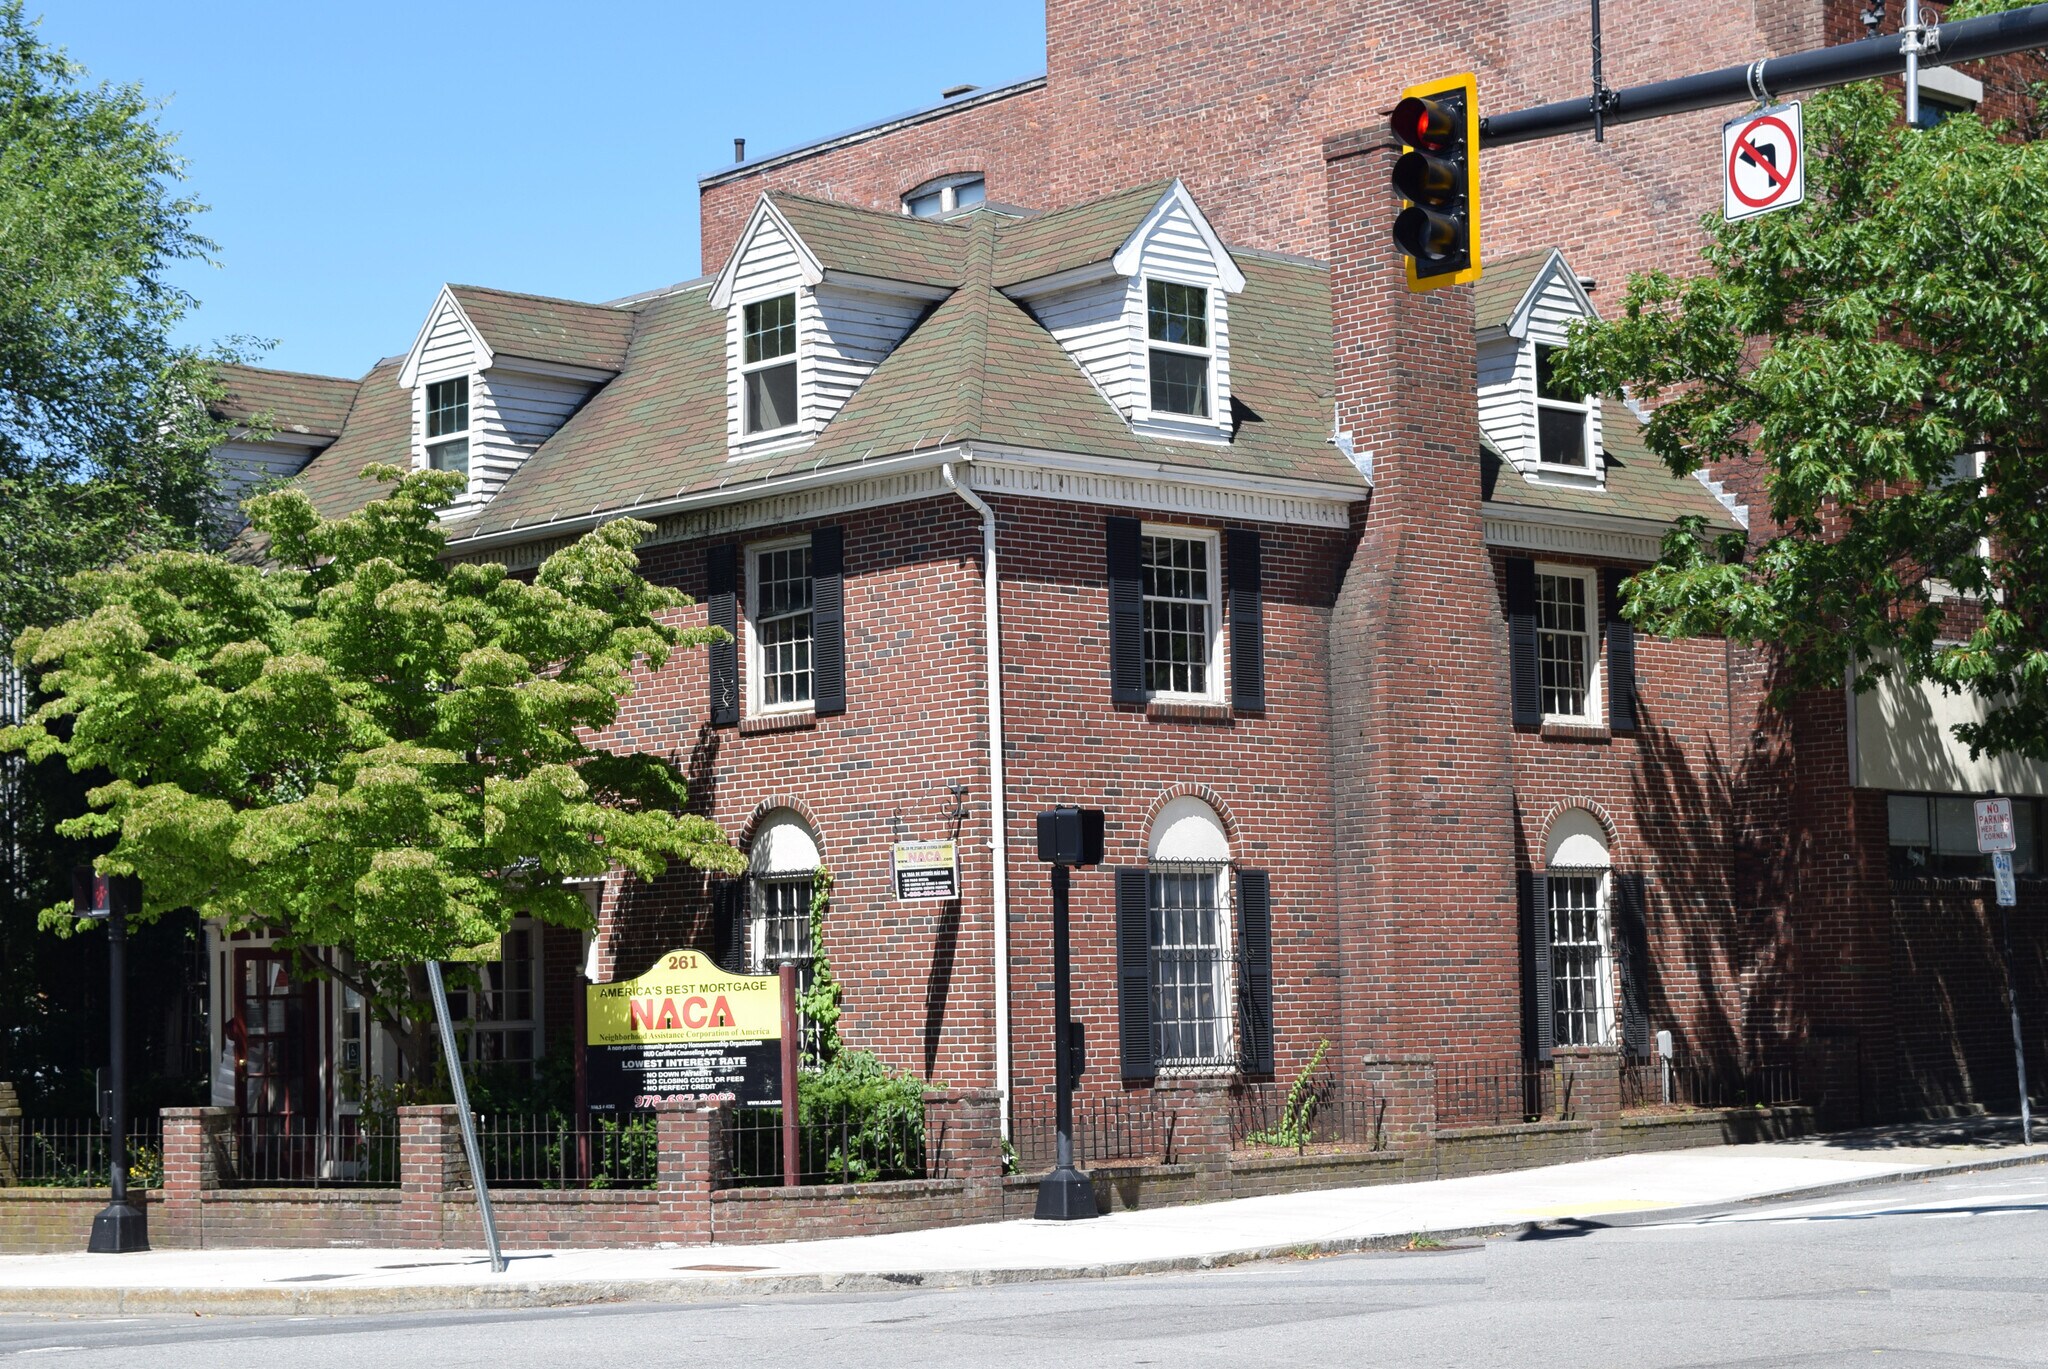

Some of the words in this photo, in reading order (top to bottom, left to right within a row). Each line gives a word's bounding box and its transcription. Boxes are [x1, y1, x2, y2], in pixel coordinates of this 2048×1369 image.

[1986, 804, 1999, 814] NO
[1979, 813, 2009, 825] PARKING
[2000, 823, 2009, 831] TO
[1983, 832, 2008, 840] CORNER
[668, 955, 698, 970] 261
[600, 986, 662, 998] AMERICA'S
[666, 984, 695, 995] BEST
[699, 981, 767, 993] MORTGAGE
[630, 995, 736, 1031] NACA
[599, 1031, 647, 1042] Neighborhood
[649, 1031, 684, 1040] Assistance
[686, 1029, 730, 1039] Corporation
[731, 1028, 739, 1036] of
[740, 1028, 770, 1036] America
[665, 1042, 687, 1050] advocacy
[688, 1040, 729, 1049] Homeownership
[729, 1040, 763, 1048] Organization
[655, 1049, 676, 1057] Certified
[676, 1048, 704, 1057] Counseling
[705, 1048, 724, 1057] Agency
[621, 1059, 663, 1069] LOWEST
[665, 1057, 717, 1067] INTEREST
[719, 1056, 747, 1065] RATE
